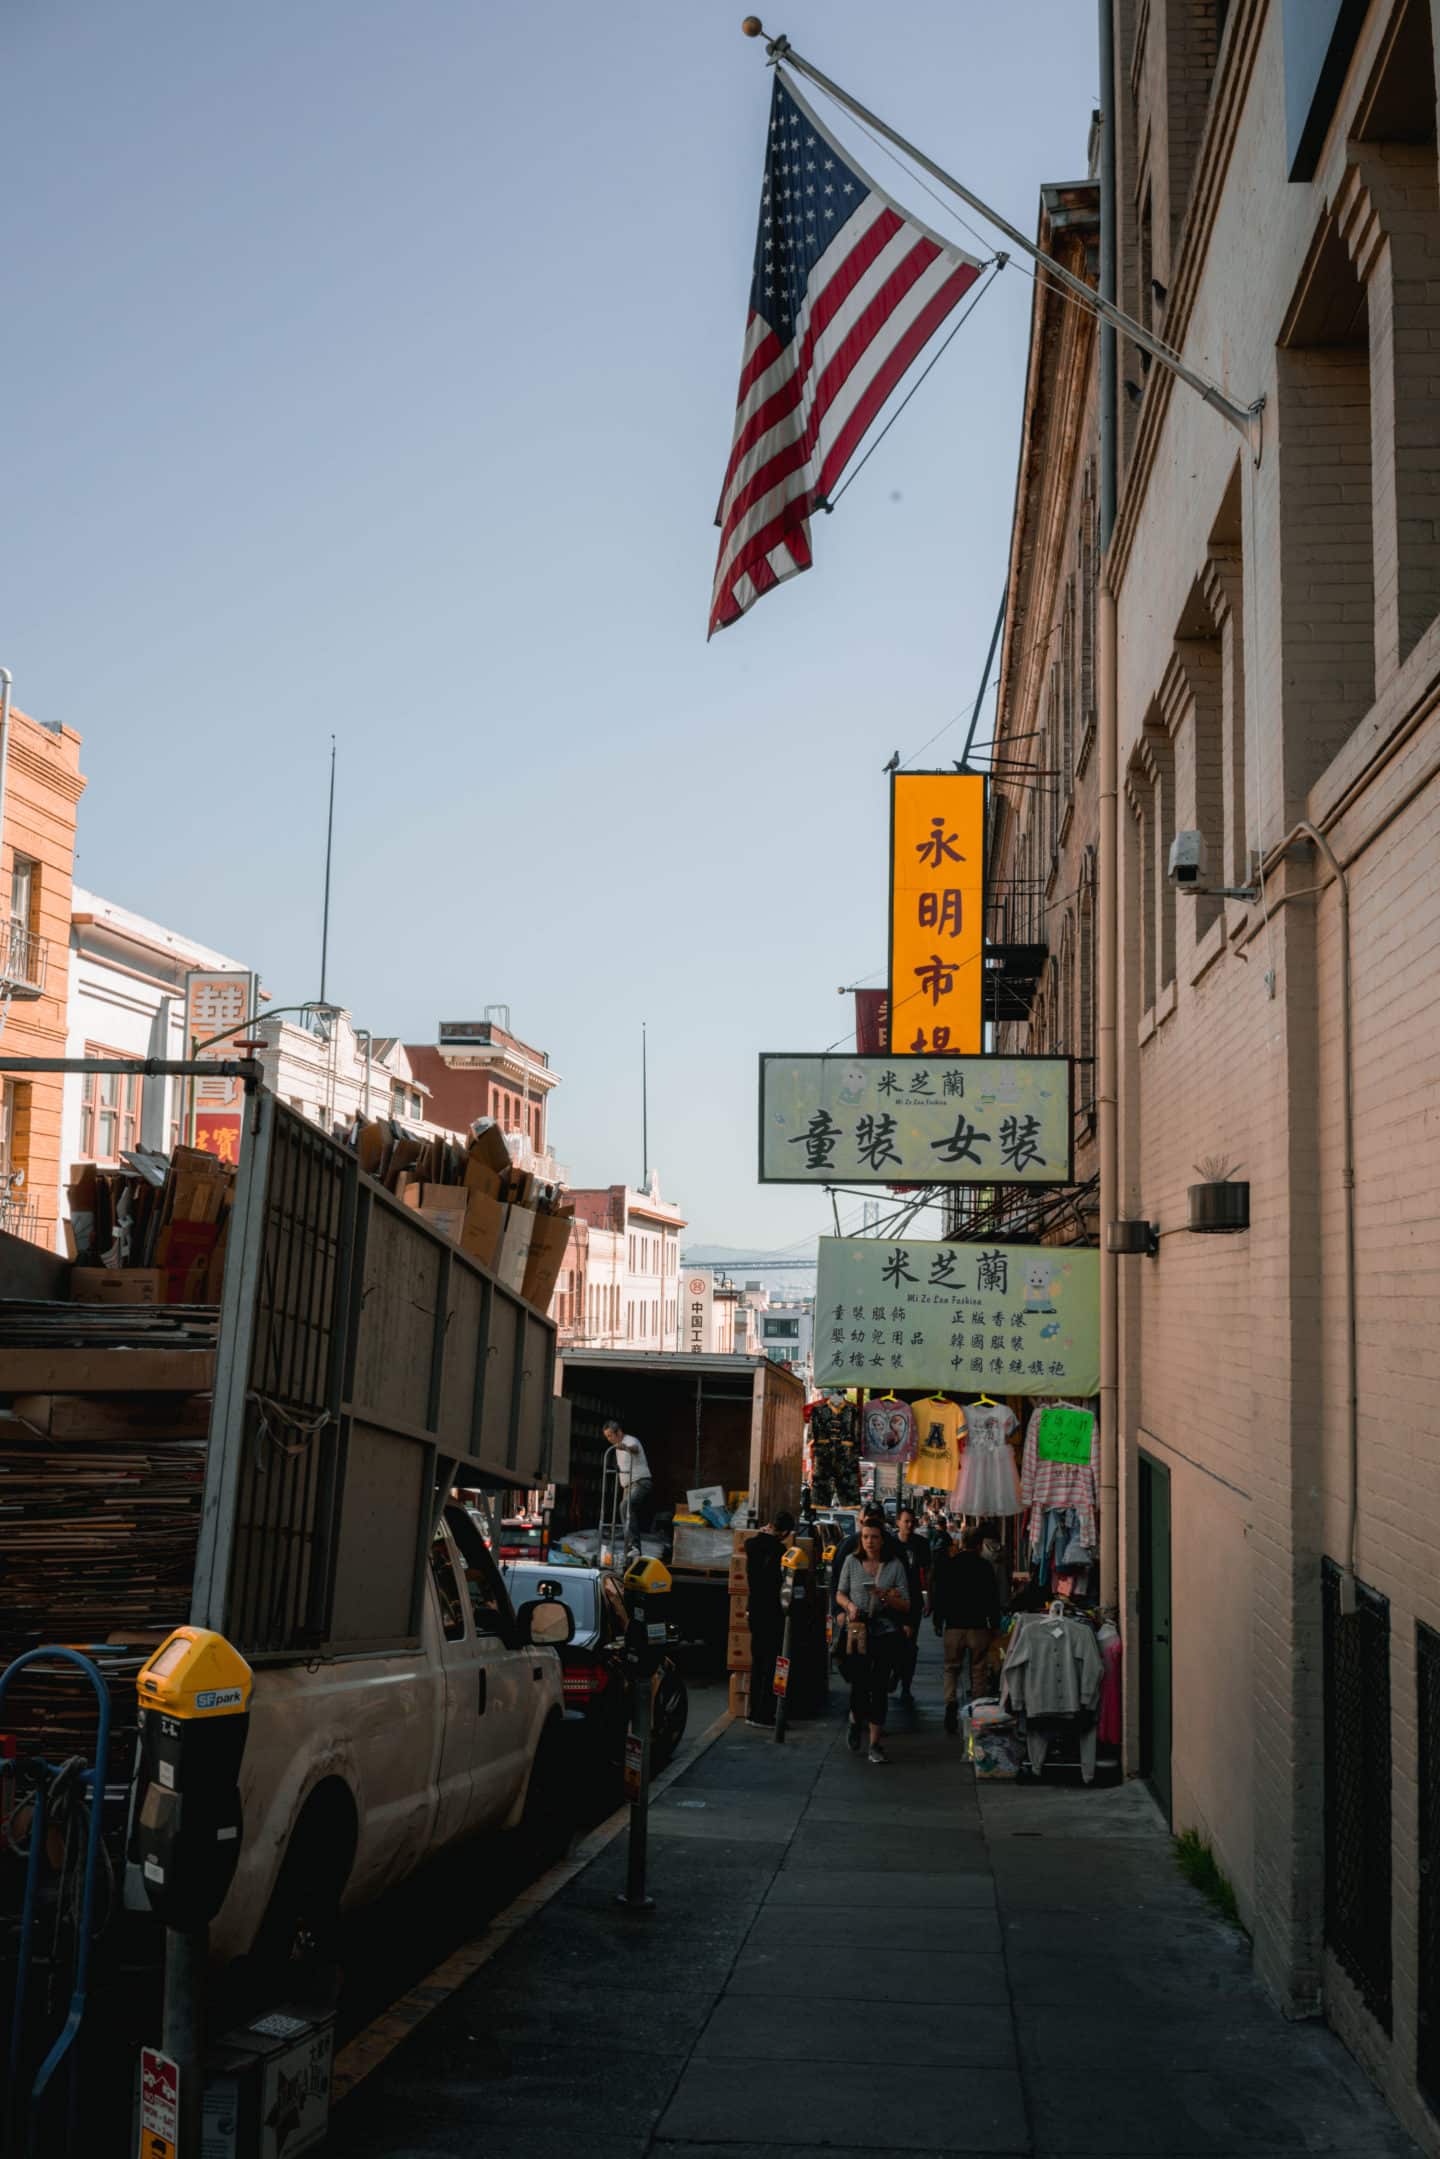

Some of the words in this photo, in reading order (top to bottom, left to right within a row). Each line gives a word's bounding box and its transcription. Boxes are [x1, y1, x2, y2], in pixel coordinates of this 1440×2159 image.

[877, 1069, 965, 1098] 米芝蘭
[788, 1109, 902, 1171] 童裝
[930, 1114, 1046, 1173] 女裝
[881, 1248, 1008, 1294] 米芝蘭
[832, 1304, 906, 1322] 童裝服飾
[951, 1310, 1026, 1327] 正版香港
[832, 1328, 924, 1345] 嬰幼兒用品
[950, 1333, 1025, 1351] 韓國服裝
[925, 1423, 946, 1448] A
